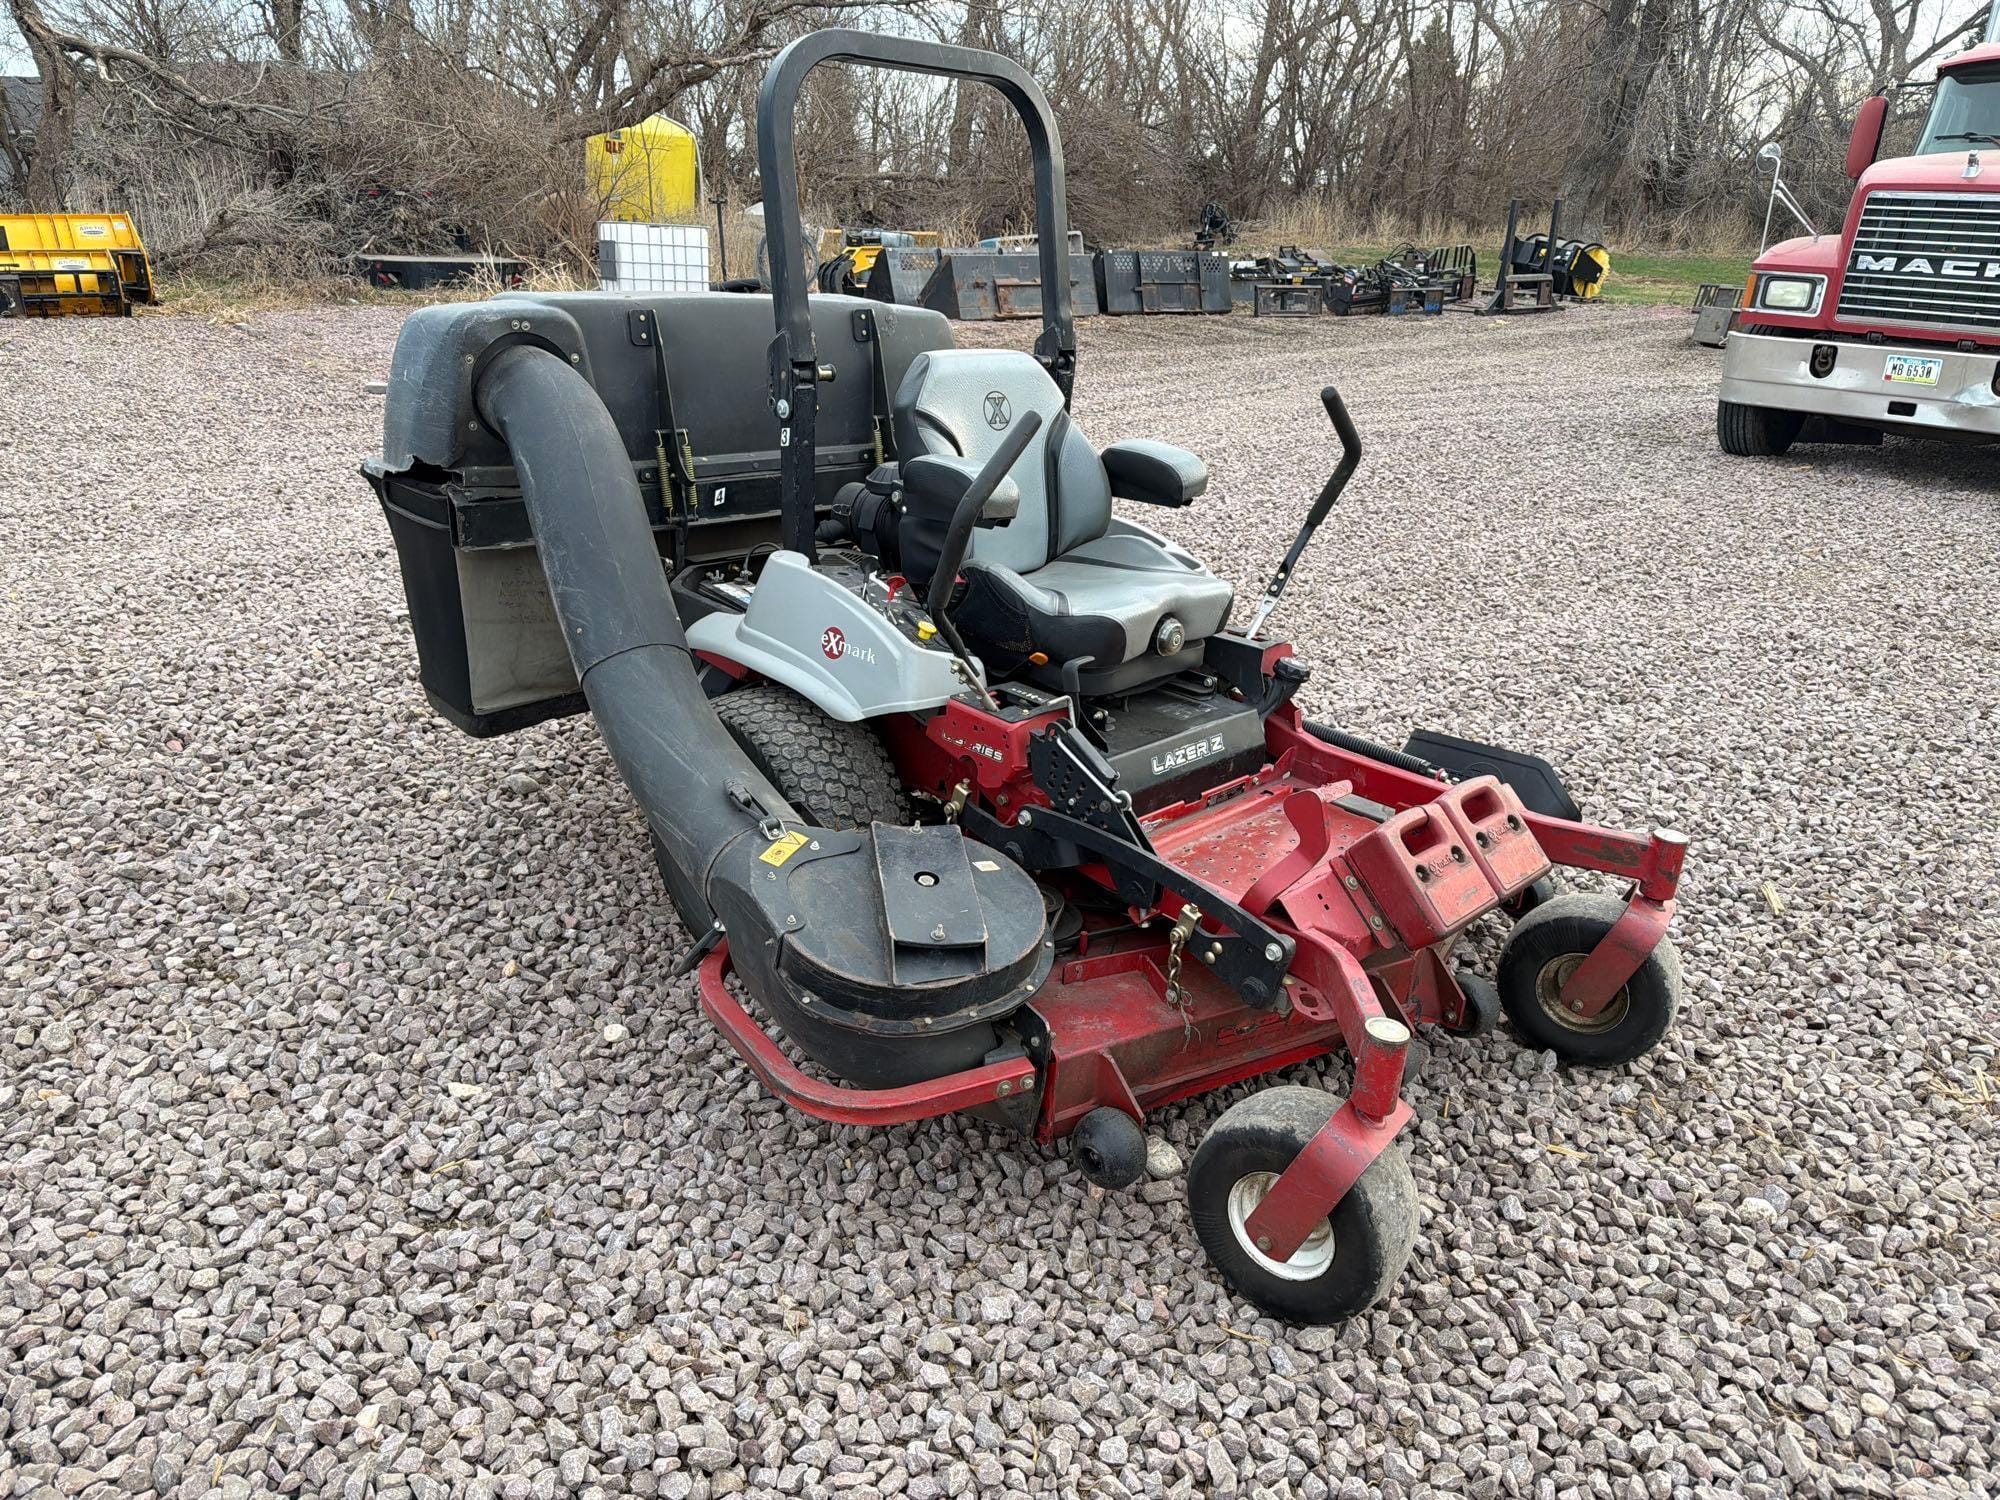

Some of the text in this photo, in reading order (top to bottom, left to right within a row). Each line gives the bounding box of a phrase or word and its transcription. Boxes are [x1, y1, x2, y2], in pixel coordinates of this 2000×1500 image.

[1891, 363, 1933, 379] MB 6530
[821, 630, 876, 664] eXmark
[1152, 733, 1224, 774] LAZER Z
